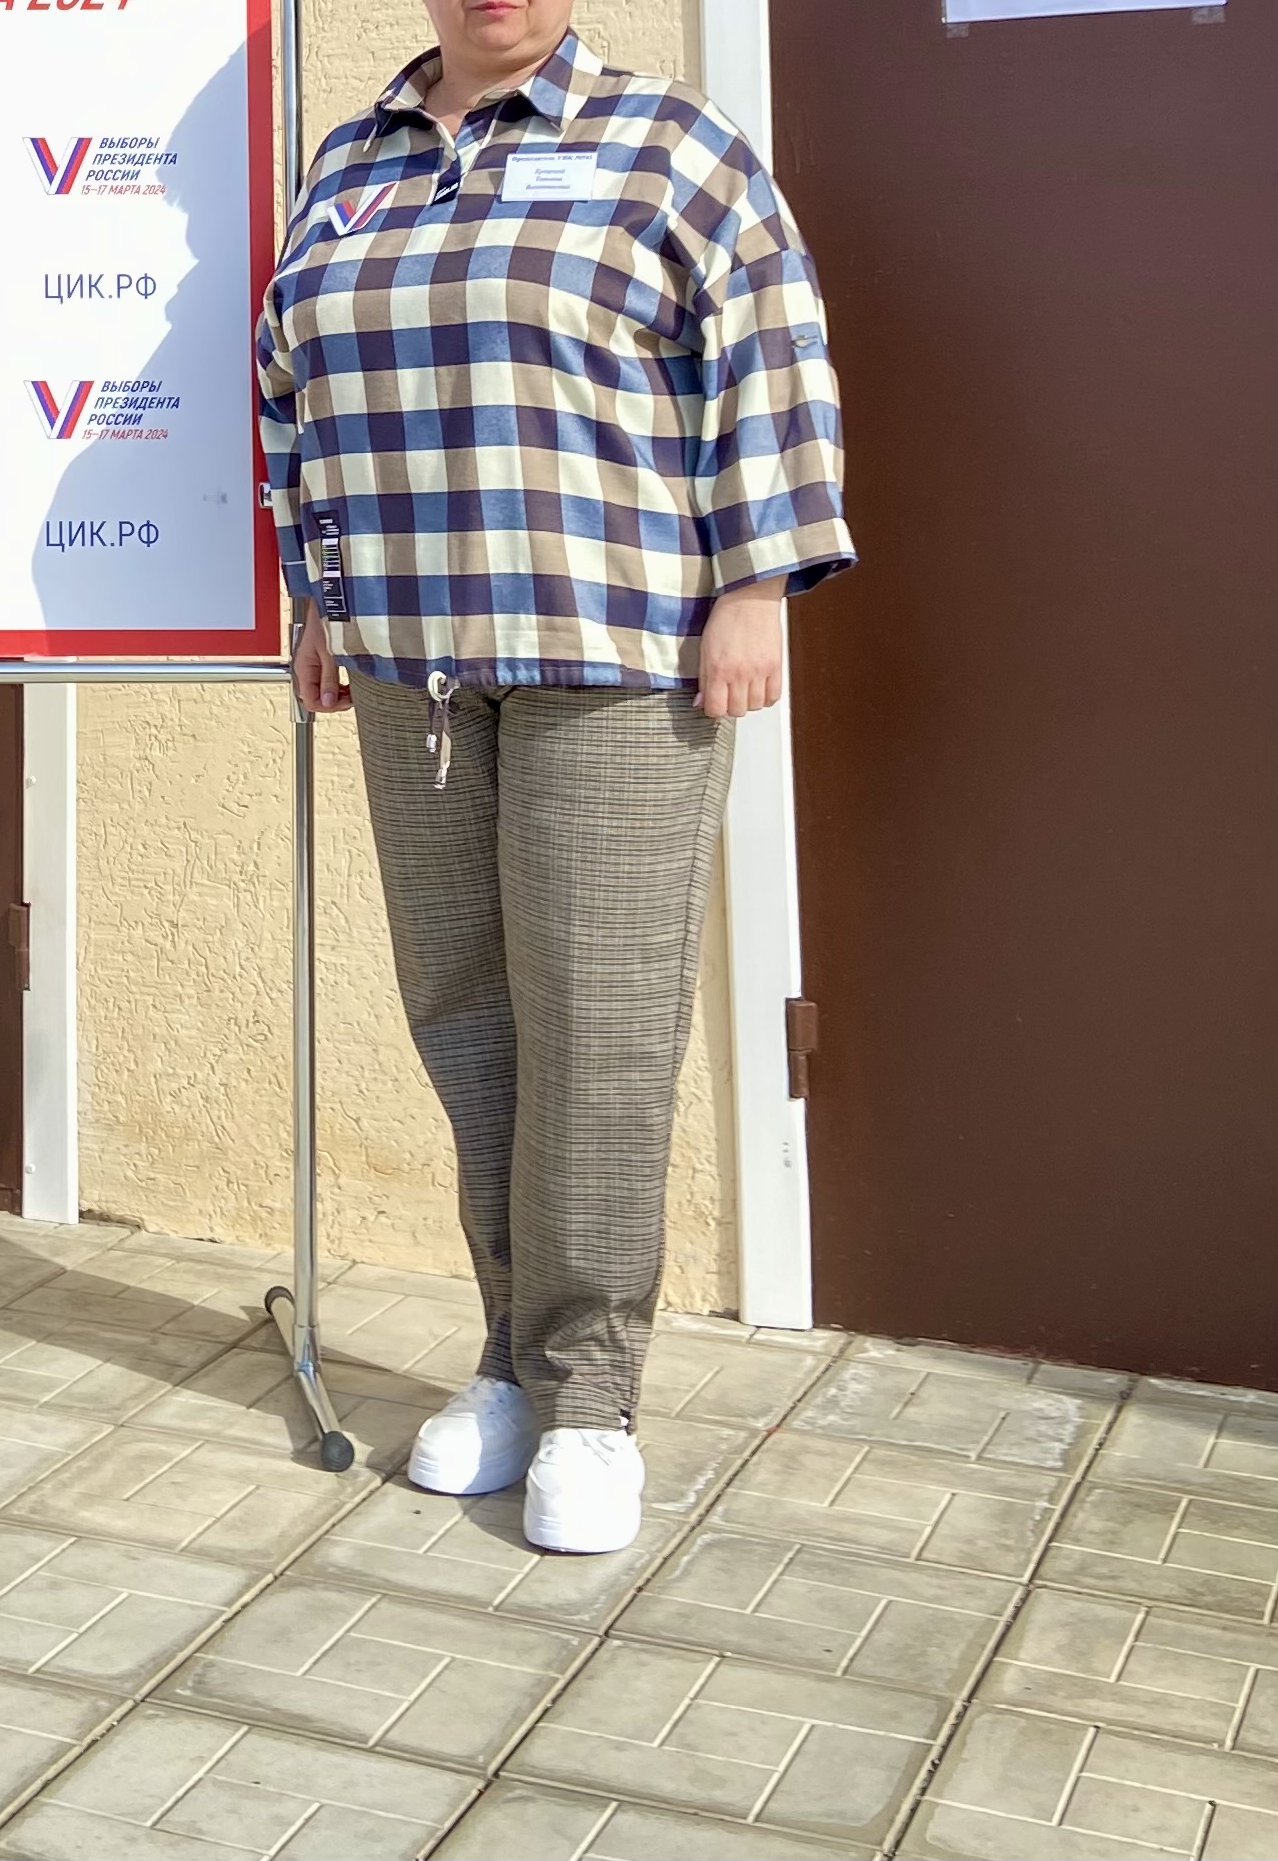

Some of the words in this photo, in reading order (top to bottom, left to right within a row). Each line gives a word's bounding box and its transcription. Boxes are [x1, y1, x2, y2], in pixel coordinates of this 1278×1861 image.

[99, 137, 159, 149] ВЫБОРЫ
[92, 153, 177, 166] ПРЕЗИДЕНТА
[85, 170, 140, 181] РОССИИ
[108, 185, 141, 195] МАРТА
[142, 184, 167, 195] 2024
[44, 273, 157, 304] ЦИК.РФ
[101, 380, 162, 393] ВЫБОРЫ
[94, 396, 180, 409] ПРЕЗИДЕНТА
[87, 413, 142, 425] РОССИИ
[110, 429, 144, 439] МАРТА
[145, 429, 168, 439] 2024
[46, 520, 159, 552] ЦИК.РФ
